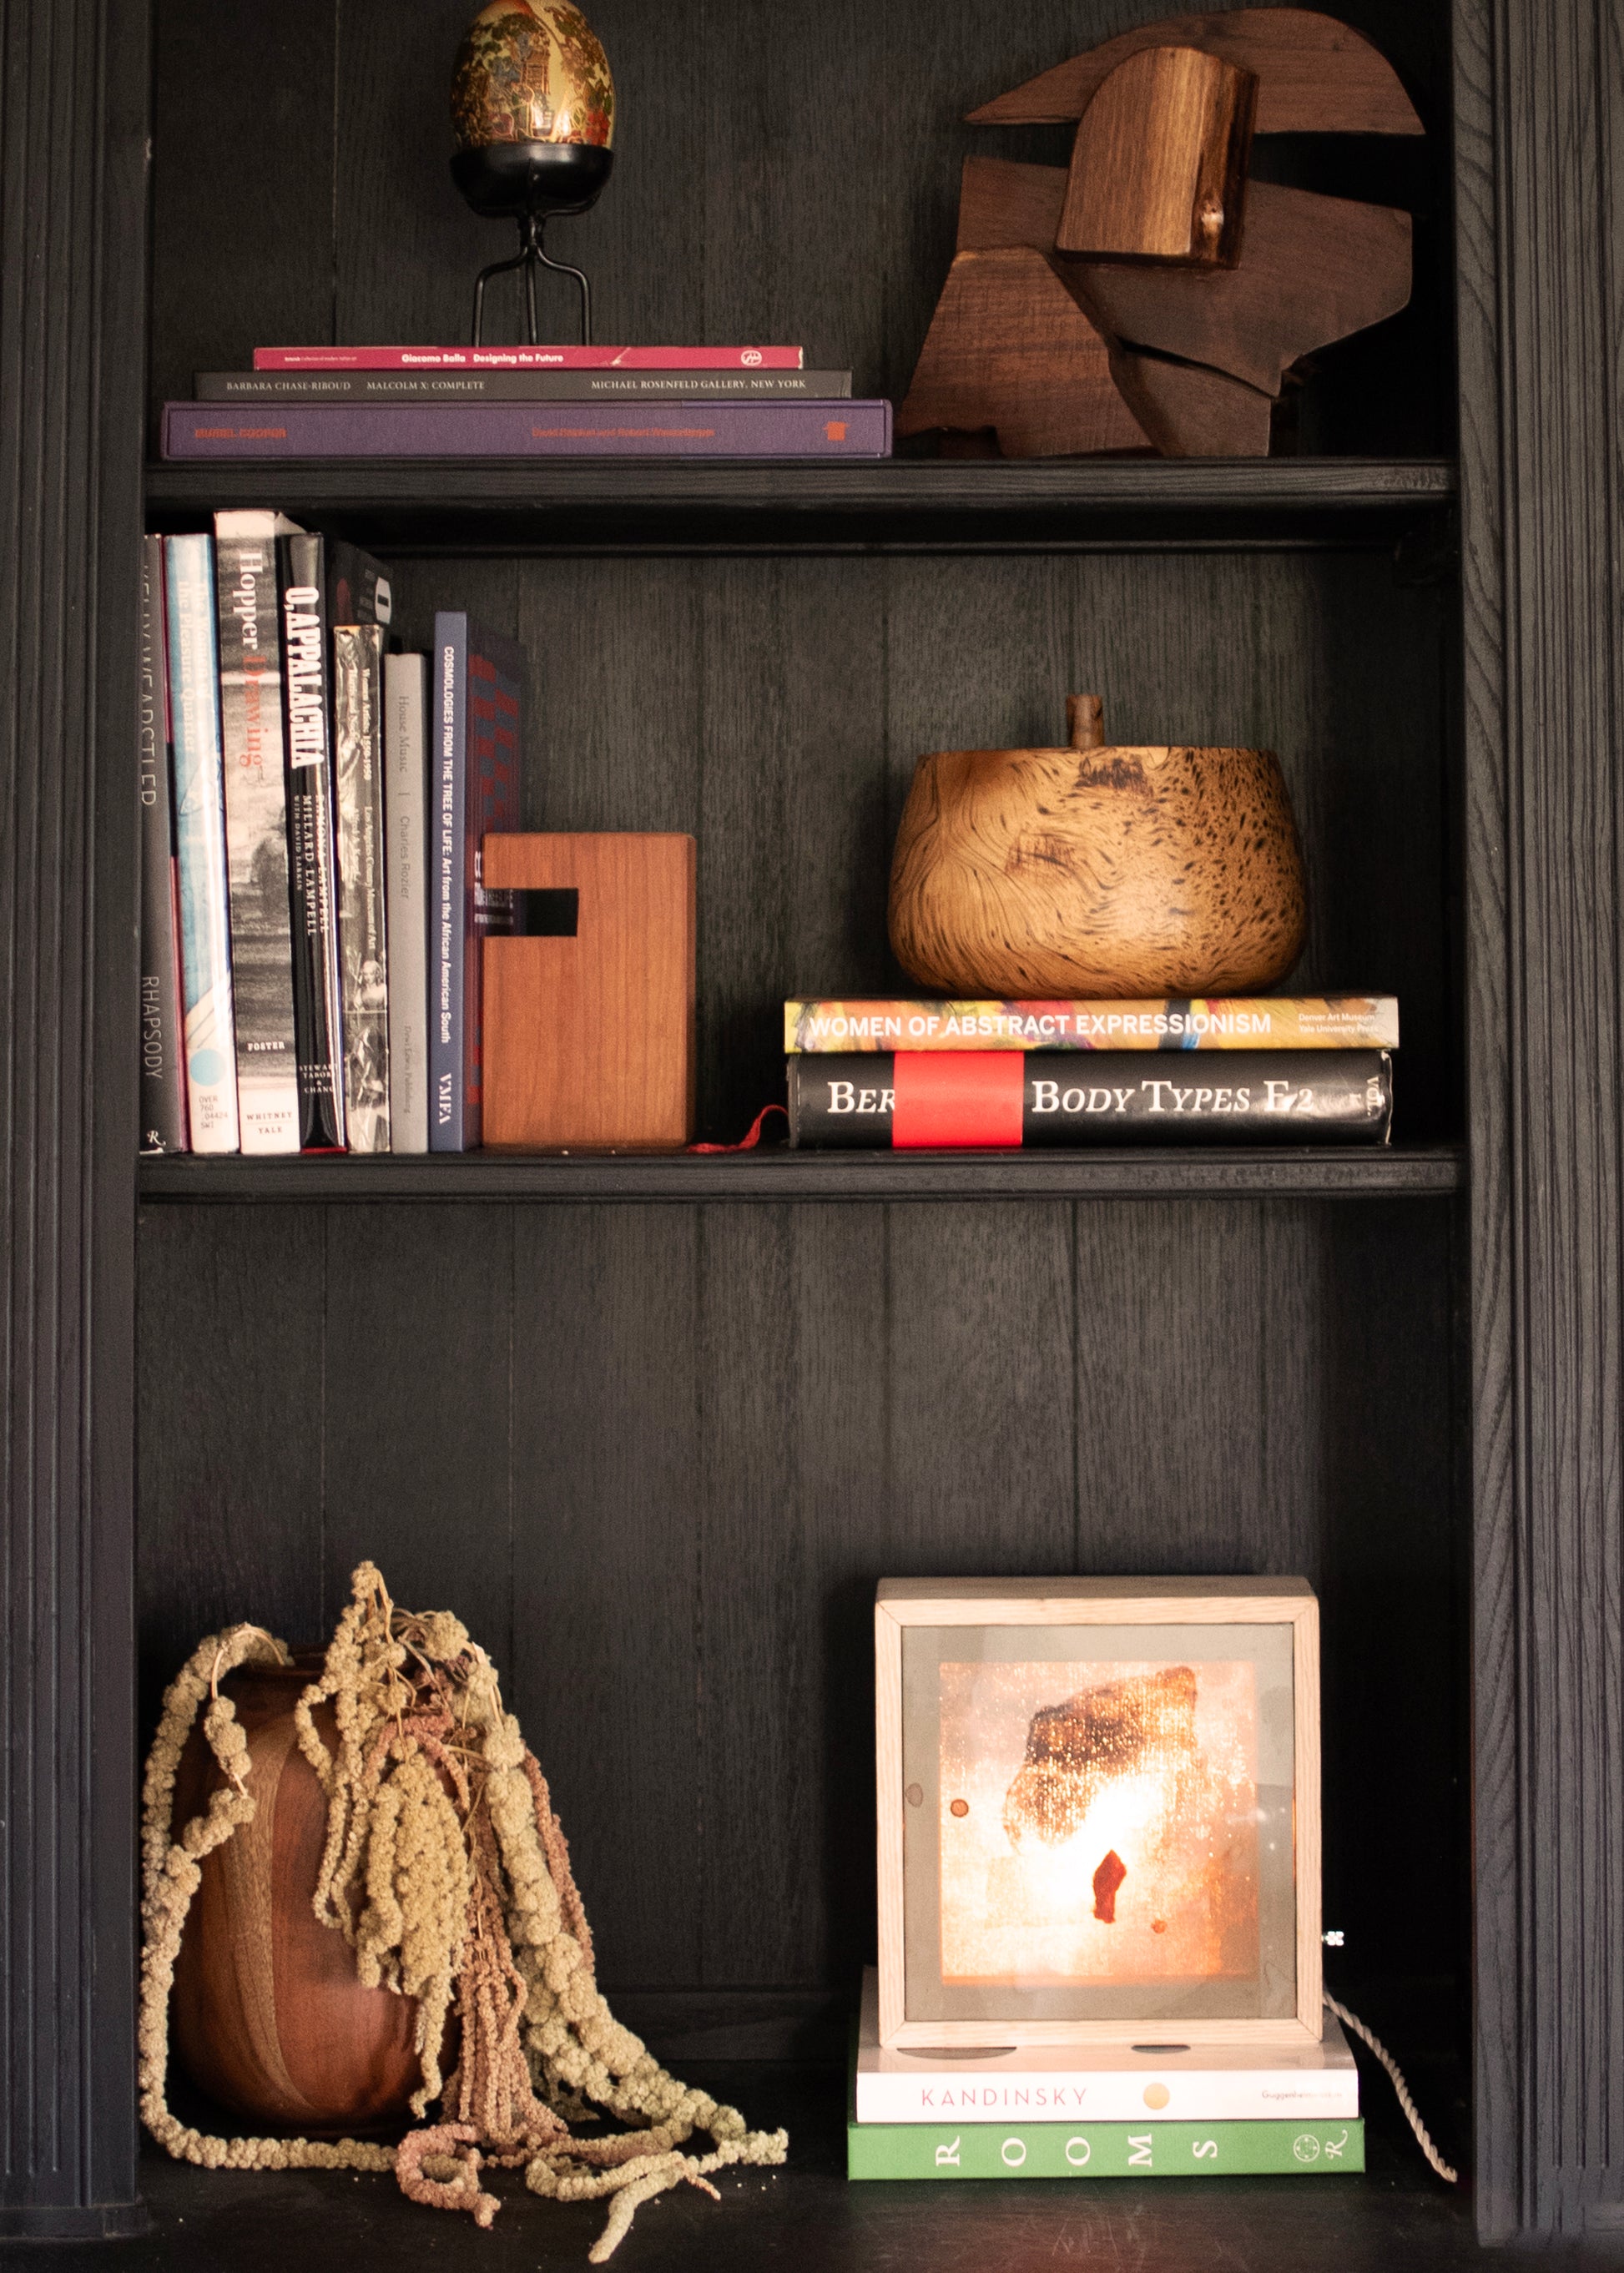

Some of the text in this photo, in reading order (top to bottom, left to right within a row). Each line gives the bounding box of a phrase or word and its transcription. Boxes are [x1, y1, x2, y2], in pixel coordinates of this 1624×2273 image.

[401, 354, 467, 363] Giacomo Balla
[473, 353, 564, 365] Designing the Future
[226, 381, 351, 391] BARBARA CHASE-RIBOUD
[367, 381, 419, 391] MALCOLM
[431, 381, 485, 390] COMPLETE
[591, 381, 638, 390] MICHAEL
[640, 381, 699, 390] ROSENFELD
[750, 380, 776, 390] NEW
[778, 380, 806, 389] YORK
[232, 552, 263, 650] Hopper
[179, 612, 194, 682] Pleasure
[362, 668, 371, 701] Women
[180, 688, 198, 753] Quarter
[240, 656, 269, 767] Drawing
[398, 694, 411, 773] House Music
[401, 815, 411, 900] Charles Rozier
[441, 646, 455, 1044] COSMOLOGIES FROM THE TREE OF LIFE: Art from the African American South
[302, 794, 317, 936] MILLARD LAMPELL
[366, 888, 375, 924] Museum
[368, 935, 376, 950] Art
[142, 975, 164, 1081] RHAPSODY
[809, 1014, 1272, 1036] WOMEN OF ABSTRACT EXPRESSIONISM
[1298, 1012, 1375, 1022] Denver Art Museum
[1298, 1022, 1380, 1035] Yale University Press
[247, 1040, 285, 1051] FOSTER
[438, 1073, 452, 1125] VMFA
[1031, 1080, 1136, 1113] BODY
[1142, 1080, 1251, 1113] TYPES
[246, 1111, 293, 1121] WHITNEY
[258, 1125, 284, 1134] YALE
[921, 2088, 1087, 2107] KANDINSKY
[935, 2133, 1218, 2168] ROOMS
